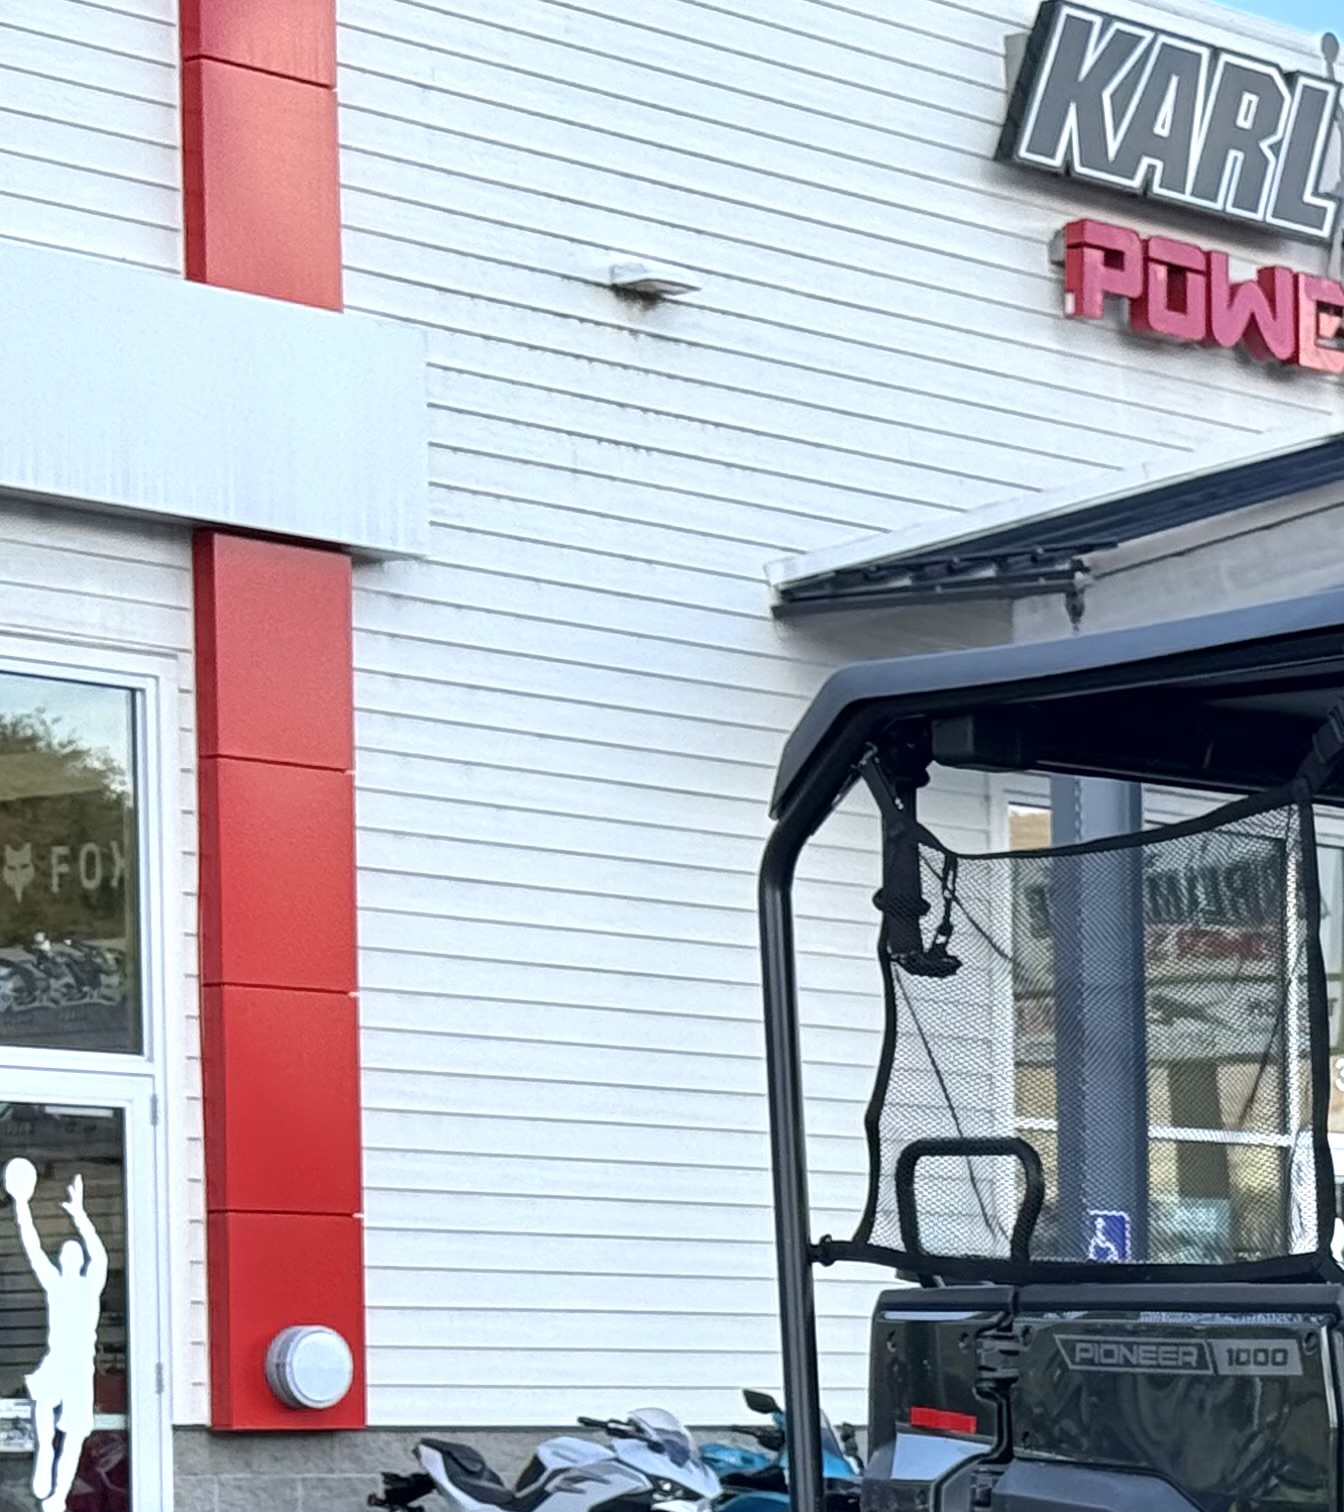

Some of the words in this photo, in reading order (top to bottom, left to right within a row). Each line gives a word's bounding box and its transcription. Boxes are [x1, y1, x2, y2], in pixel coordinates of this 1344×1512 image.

[1012, 3, 1342, 240] KARL
[1074, 1342, 1198, 1368] PIONEER
[1226, 1347, 1289, 1368] 1000
